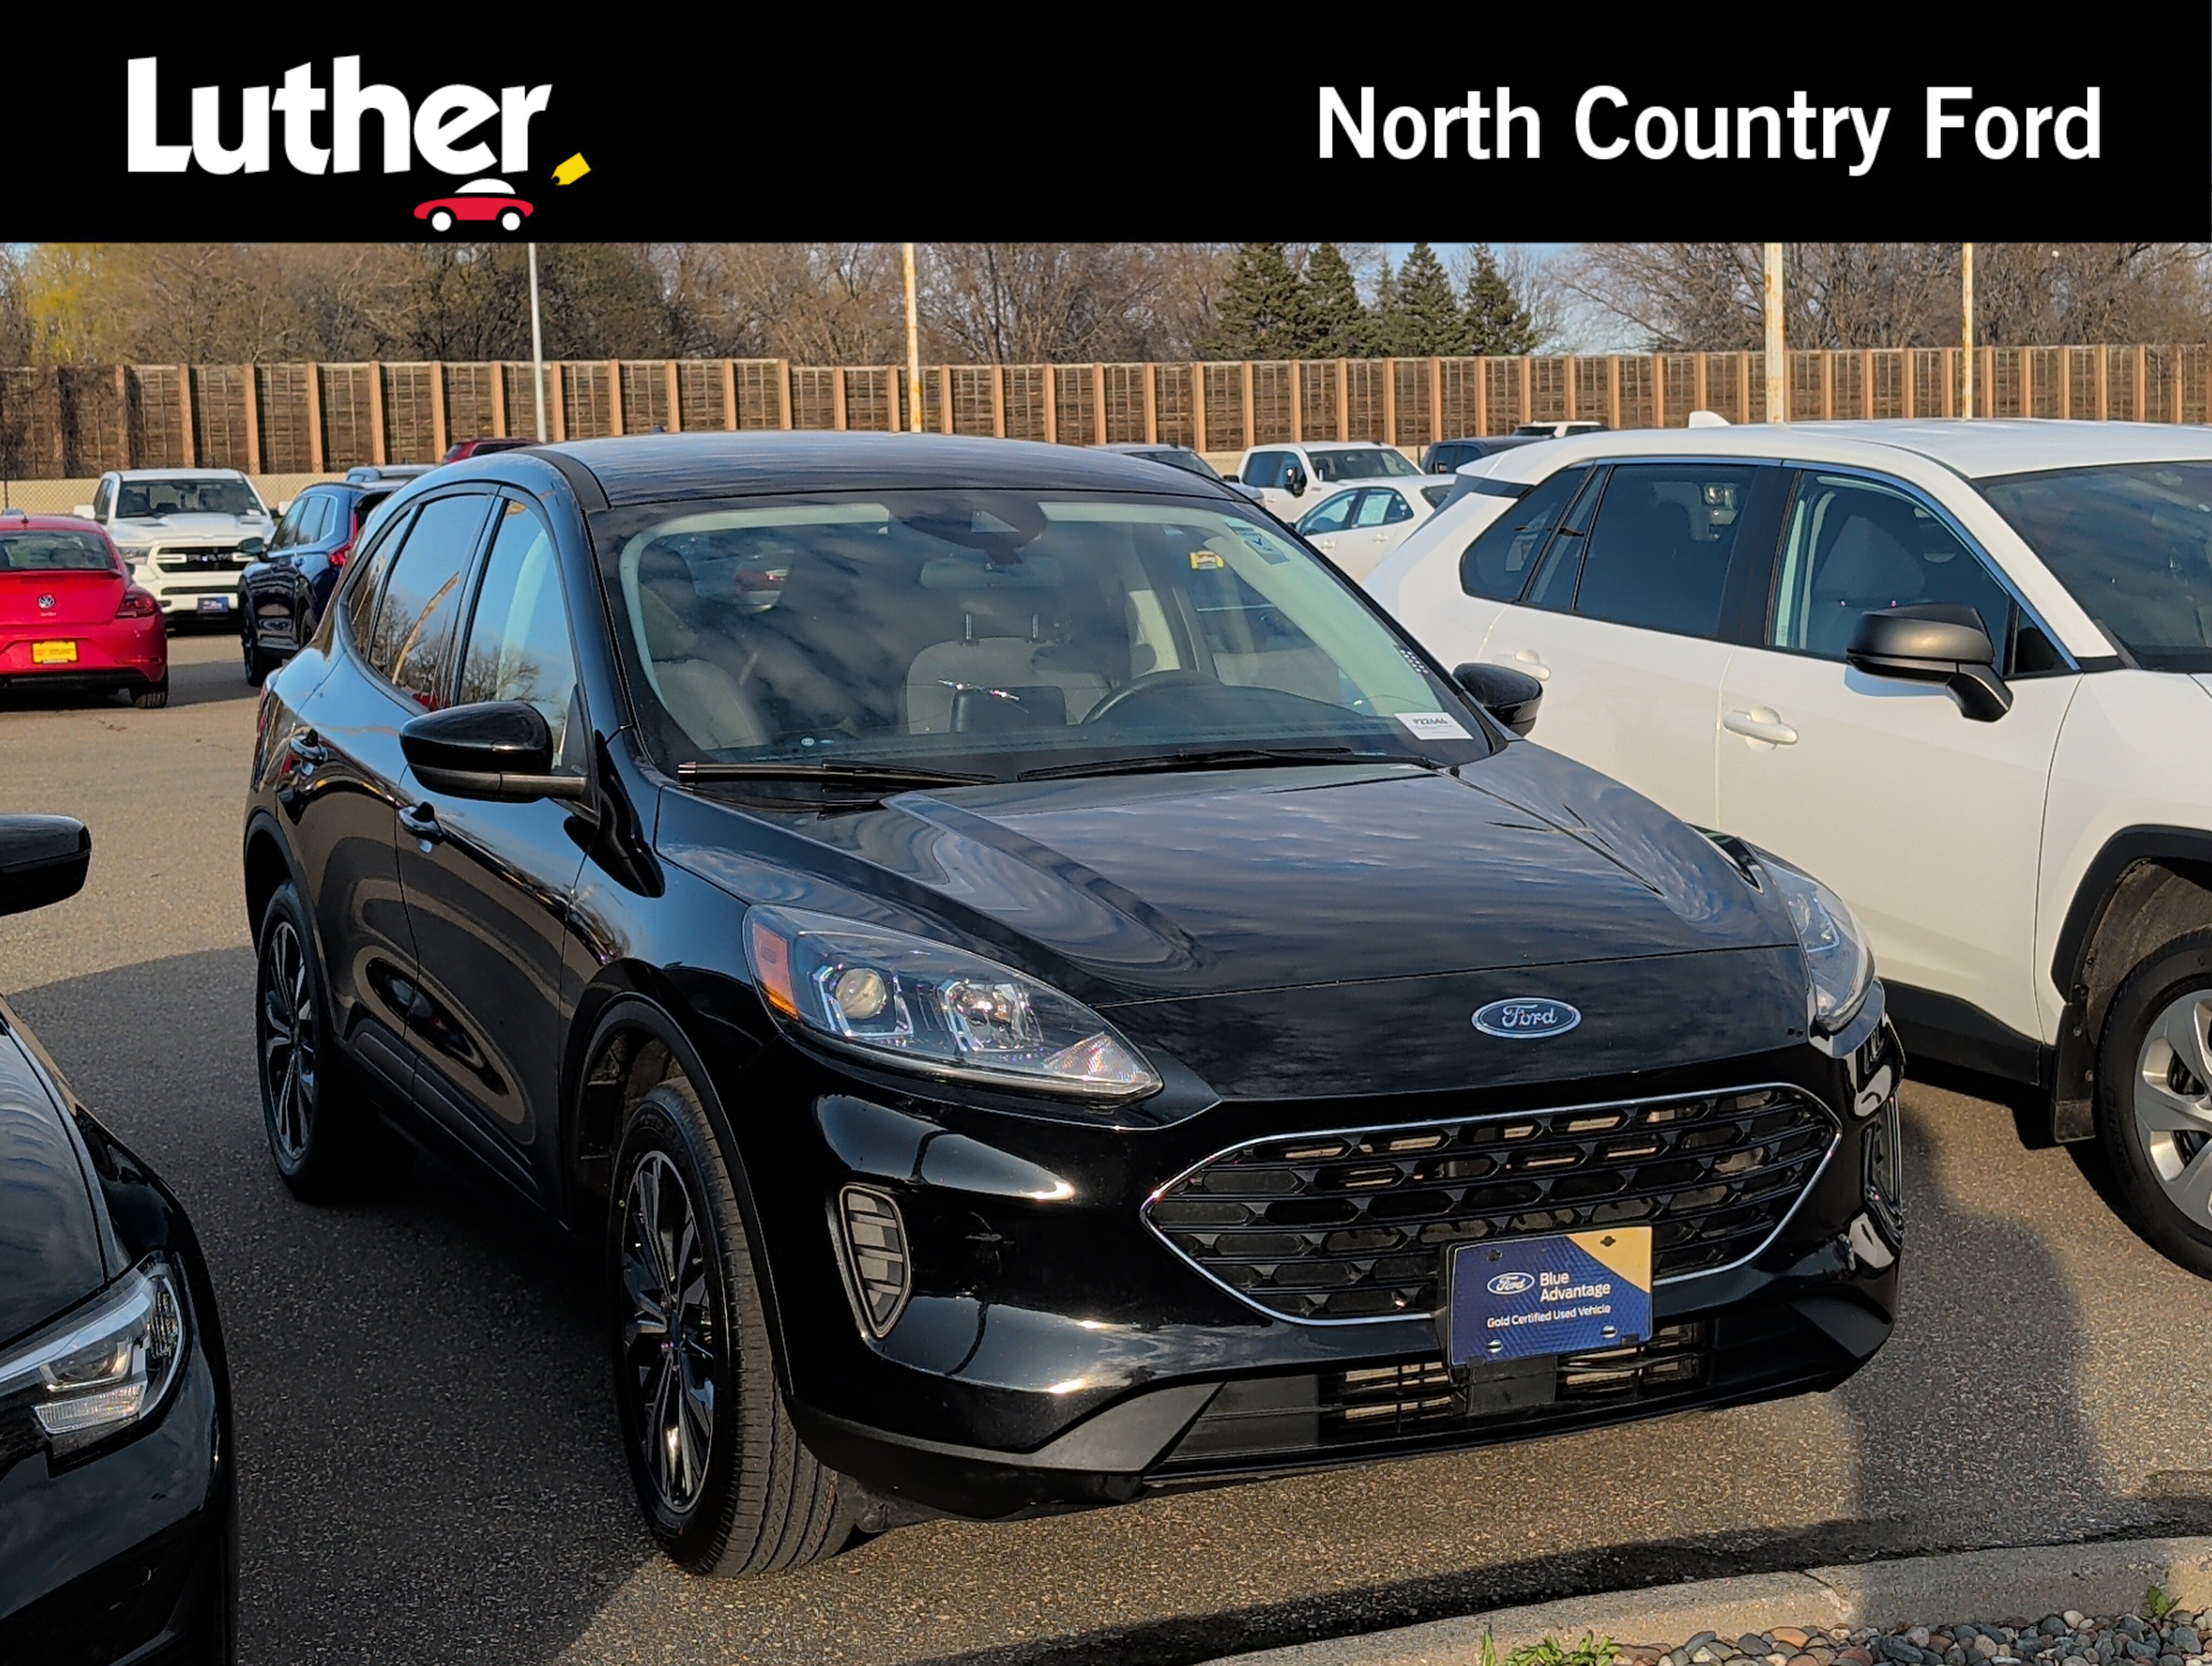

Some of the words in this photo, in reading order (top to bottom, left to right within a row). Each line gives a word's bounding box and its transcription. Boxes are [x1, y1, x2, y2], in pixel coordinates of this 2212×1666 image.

[1501, 1004, 1558, 1028] Ford
[1496, 1276, 1526, 1291] Ford
[1539, 1271, 1570, 1286] Blue
[1540, 1283, 1611, 1302] Advantage
[1487, 1315, 1510, 1328] Gold
[1512, 1311, 1552, 1325] Certified
[1553, 1306, 1577, 1319] Used
[1578, 1303, 1611, 1316] Vehicle
